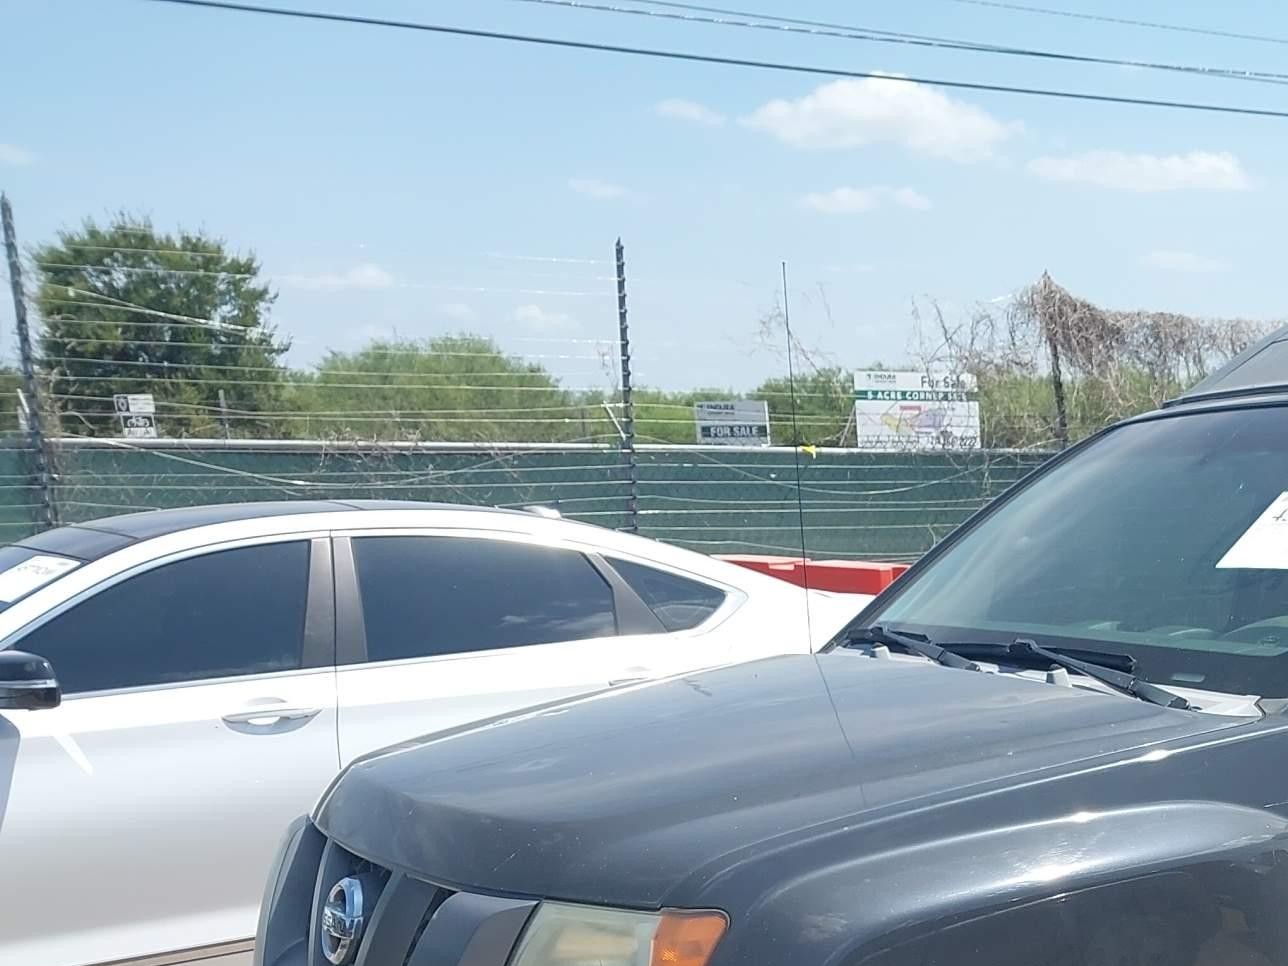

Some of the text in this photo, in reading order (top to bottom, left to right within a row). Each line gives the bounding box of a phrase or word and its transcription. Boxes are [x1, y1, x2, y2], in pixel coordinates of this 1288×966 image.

[920, 375, 940, 389] For
[877, 391, 902, 400] ACRE
[709, 426, 759, 437] FOR SALE
